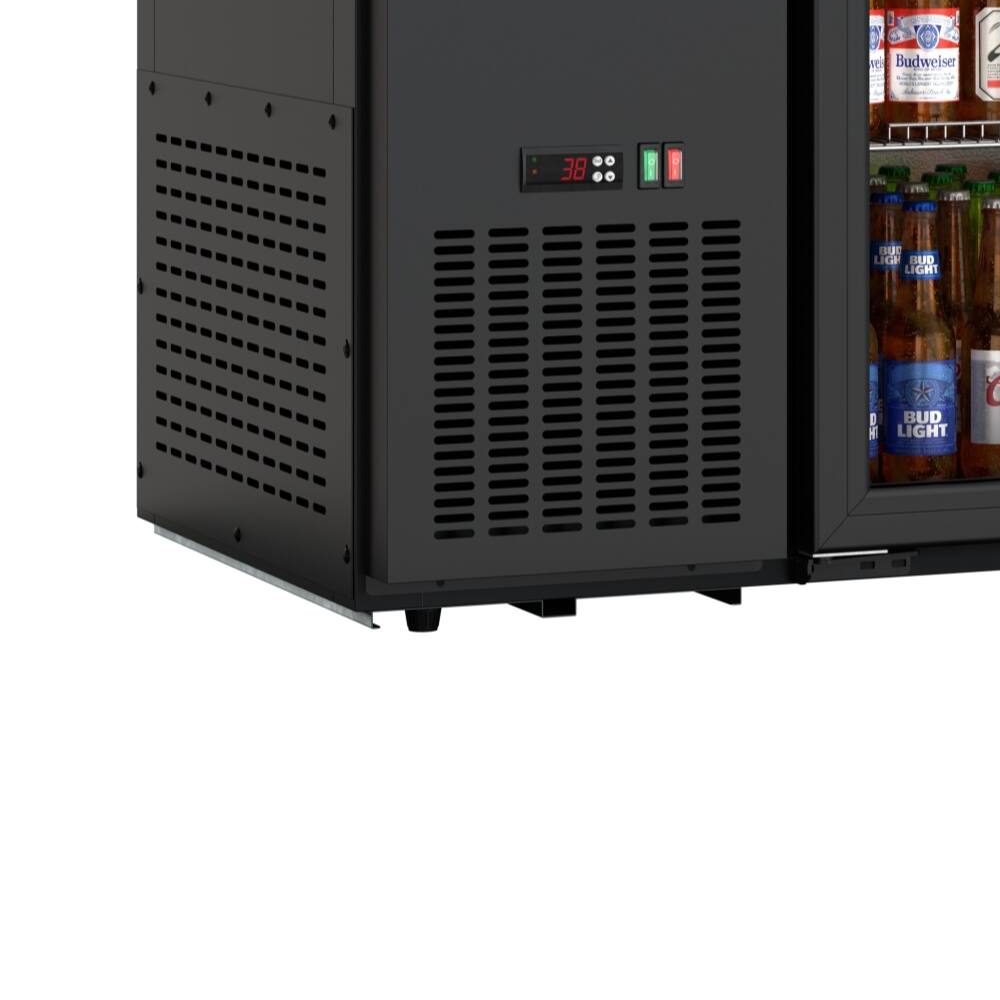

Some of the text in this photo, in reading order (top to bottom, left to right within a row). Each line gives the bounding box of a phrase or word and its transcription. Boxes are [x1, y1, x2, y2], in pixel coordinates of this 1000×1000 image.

[896, 53, 956, 68] Budweiser
[561, 157, 588, 182] 38
[909, 255, 935, 265] BUD
[904, 264, 938, 275] LIGHT
[903, 411, 942, 424] BUD
[897, 424, 949, 438] LIGHT
